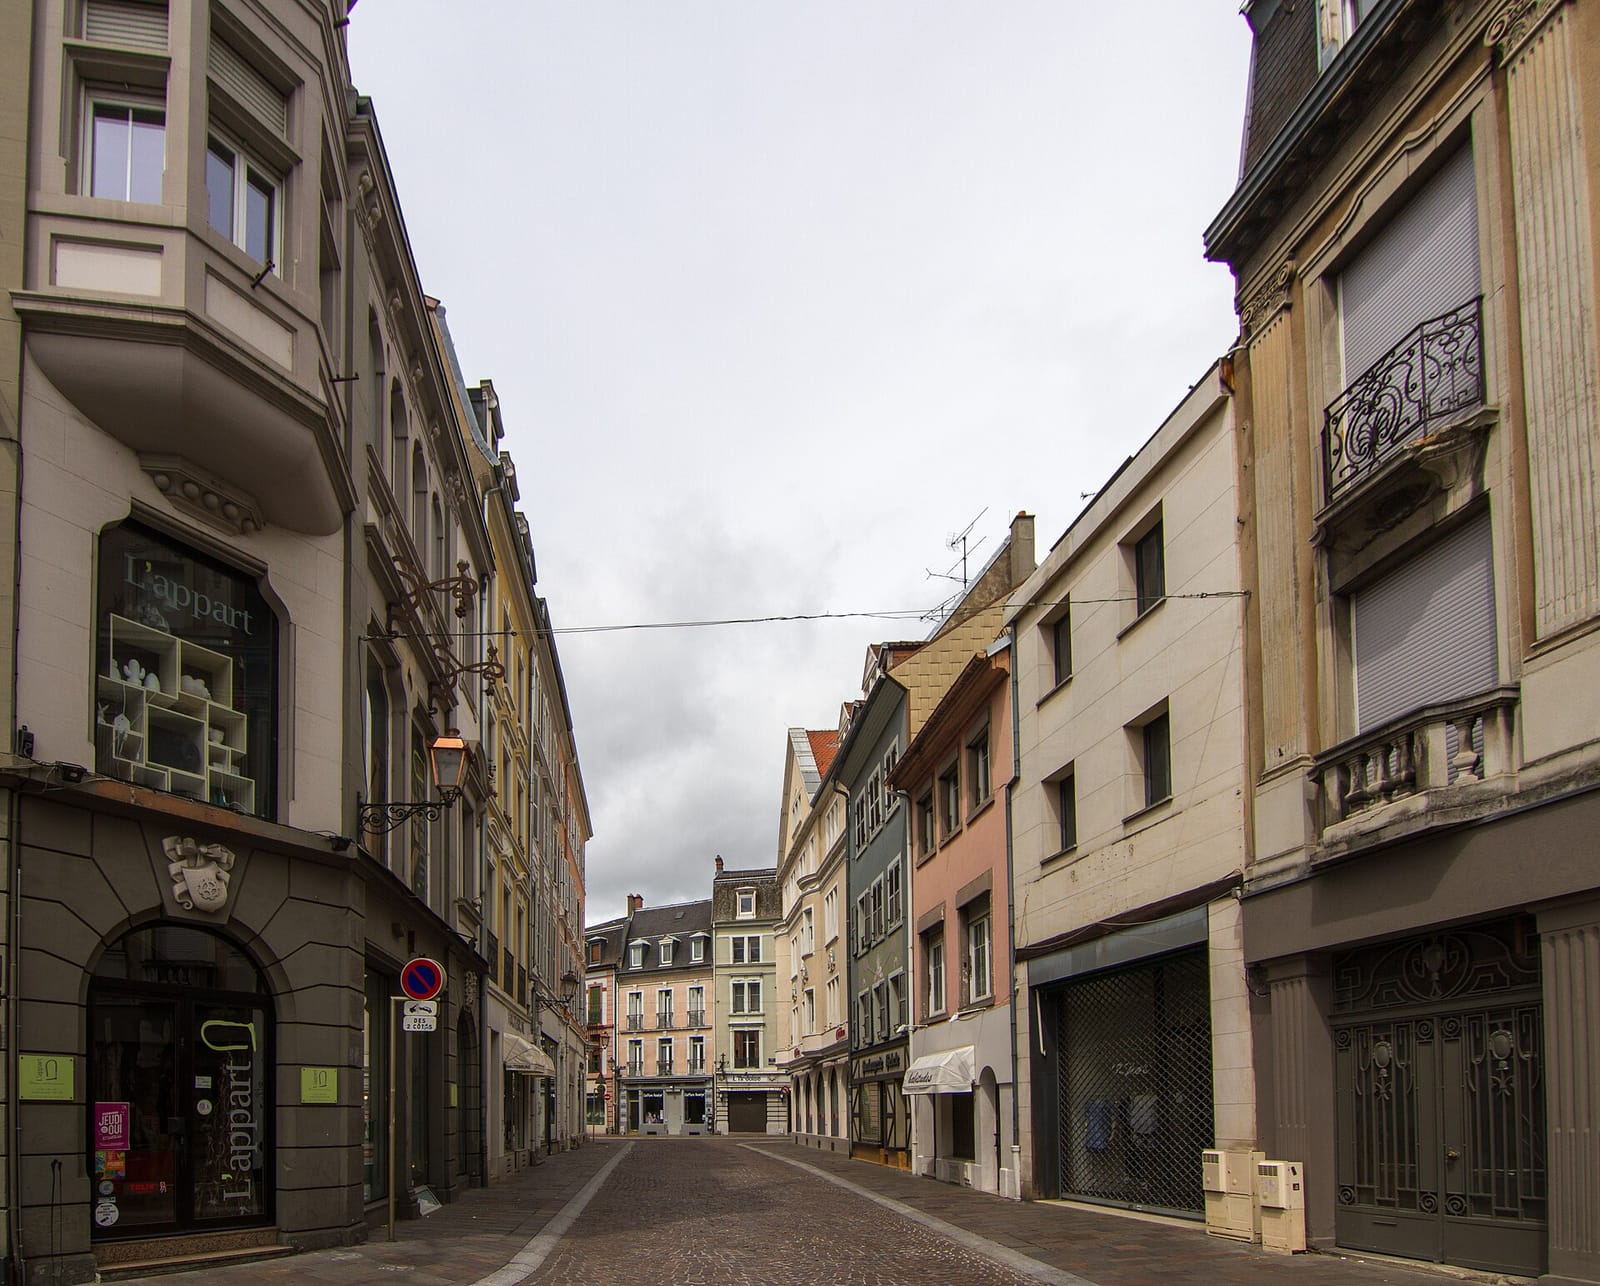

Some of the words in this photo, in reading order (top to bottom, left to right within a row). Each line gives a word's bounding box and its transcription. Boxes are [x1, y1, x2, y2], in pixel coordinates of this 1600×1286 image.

[125, 554, 254, 635] L'appart
[98, 1114, 123, 1126] JEUDI
[108, 1124, 123, 1135] OUI
[221, 1060, 259, 1202] L'appart
